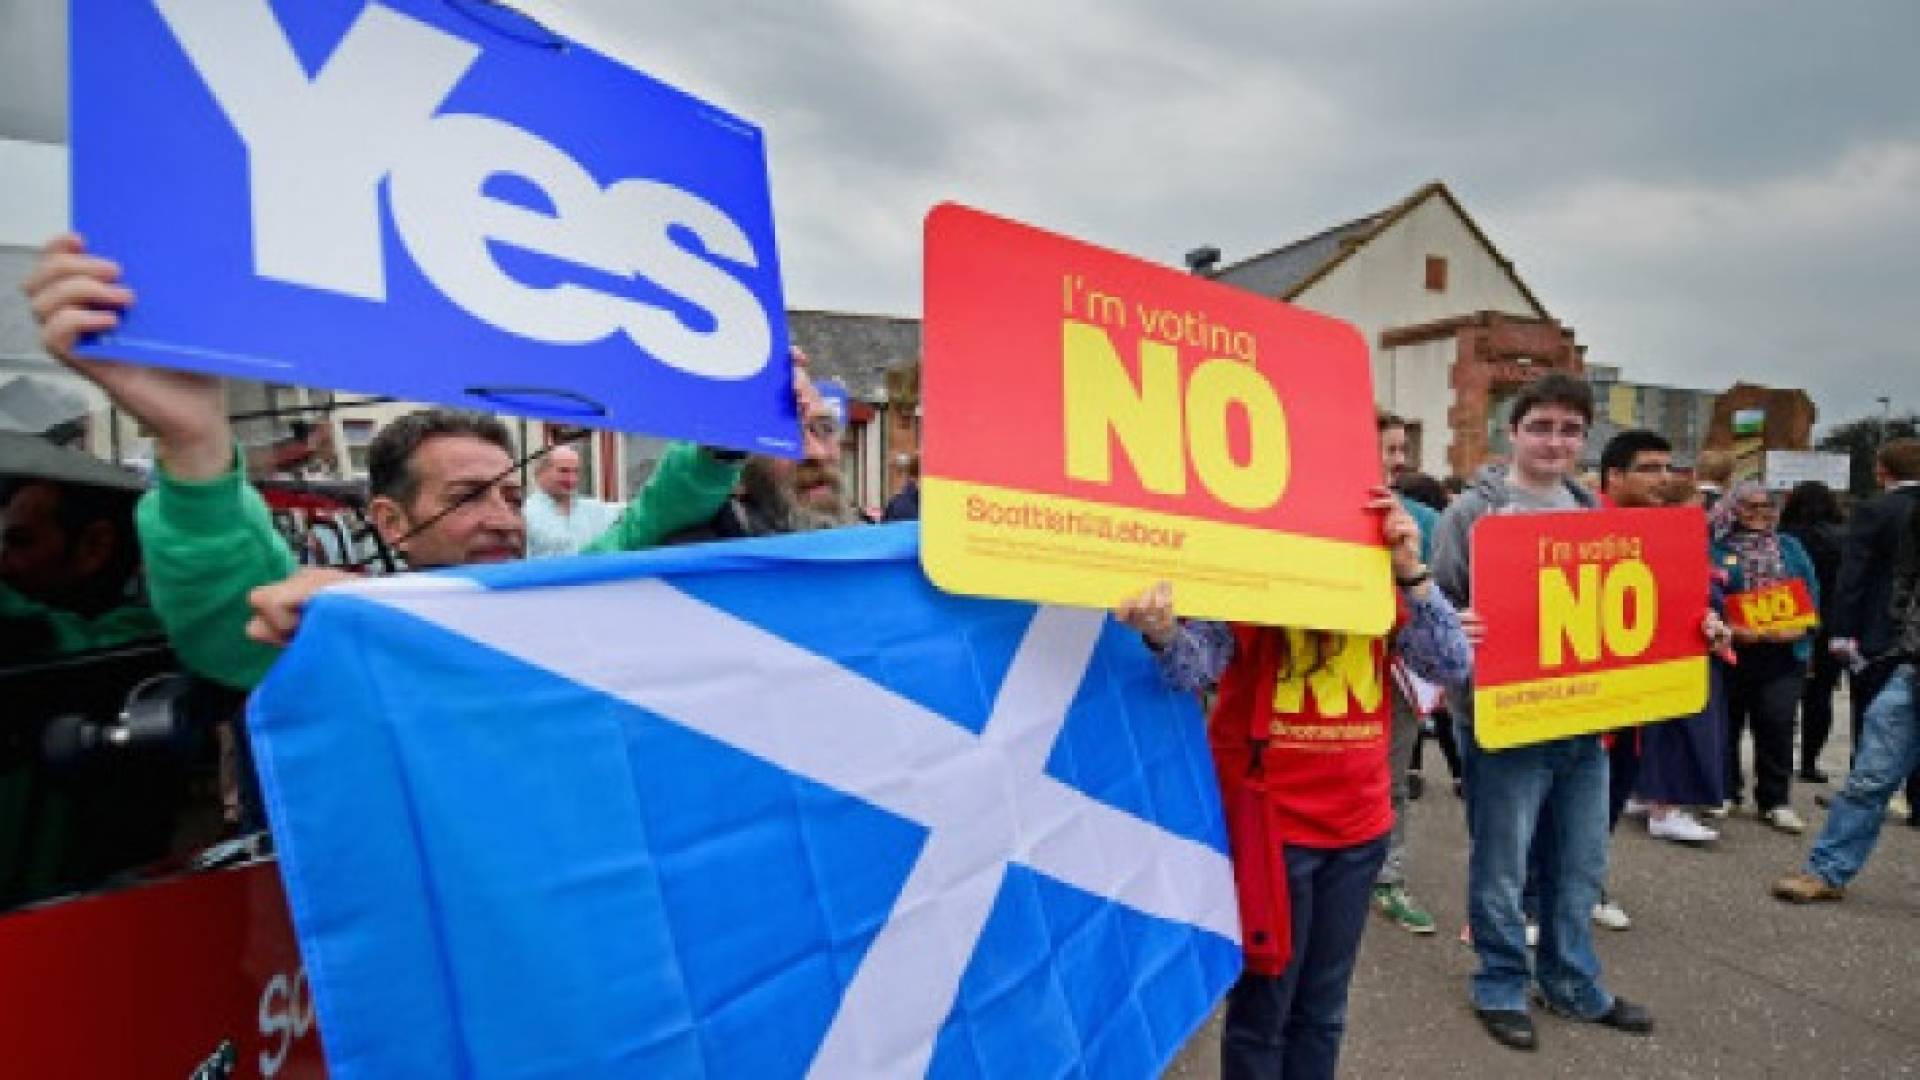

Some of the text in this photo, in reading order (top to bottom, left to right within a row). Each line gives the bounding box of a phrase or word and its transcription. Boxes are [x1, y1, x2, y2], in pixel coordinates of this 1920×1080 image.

[153, 0, 772, 382] Yes
[1063, 274, 1257, 366] I'm voting
[1063, 318, 1291, 512] NO
[1539, 559, 1658, 671] NO
[1742, 588, 1794, 624] NO
